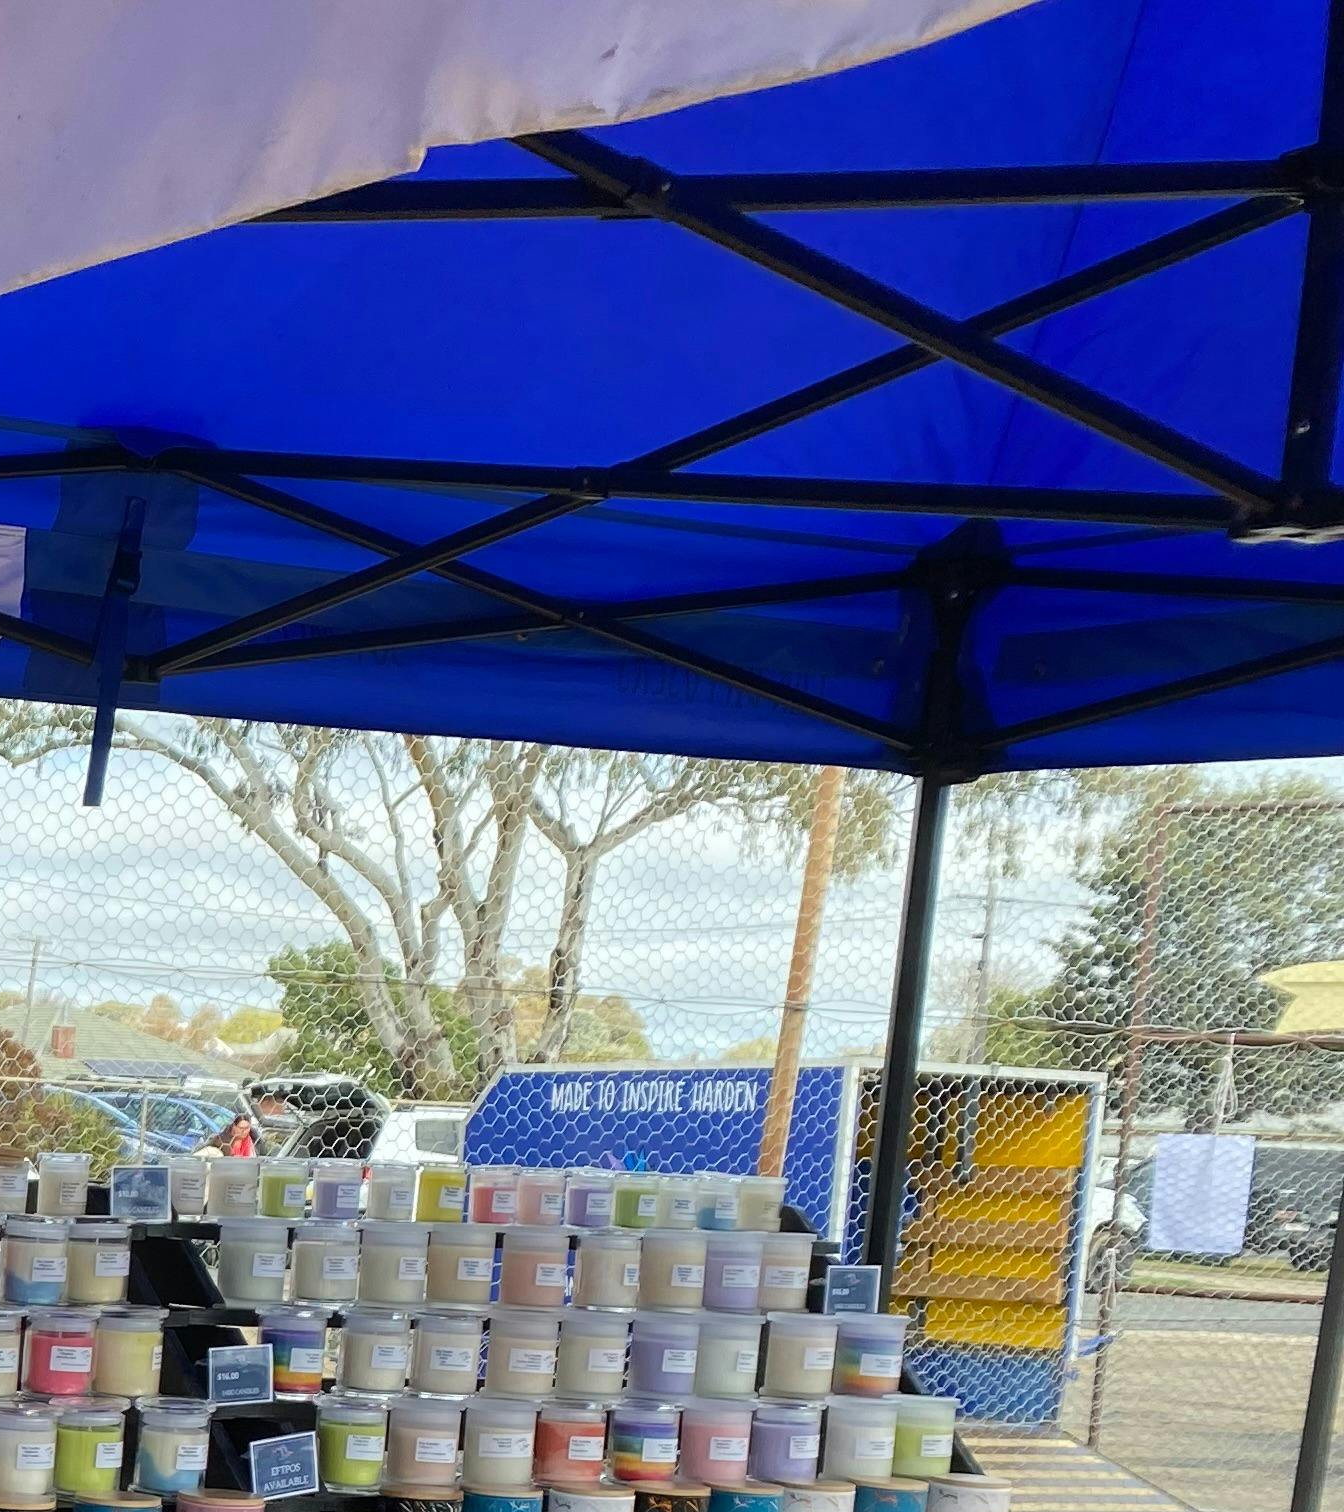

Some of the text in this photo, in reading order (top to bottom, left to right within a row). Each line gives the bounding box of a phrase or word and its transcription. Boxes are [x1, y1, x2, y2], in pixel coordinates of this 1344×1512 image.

[551, 1080, 759, 1112] MADE TO INSPIRE HARDEN
[270, 1462, 302, 1477] EFTPOS
[263, 1475, 310, 1492] AVAILABLE
